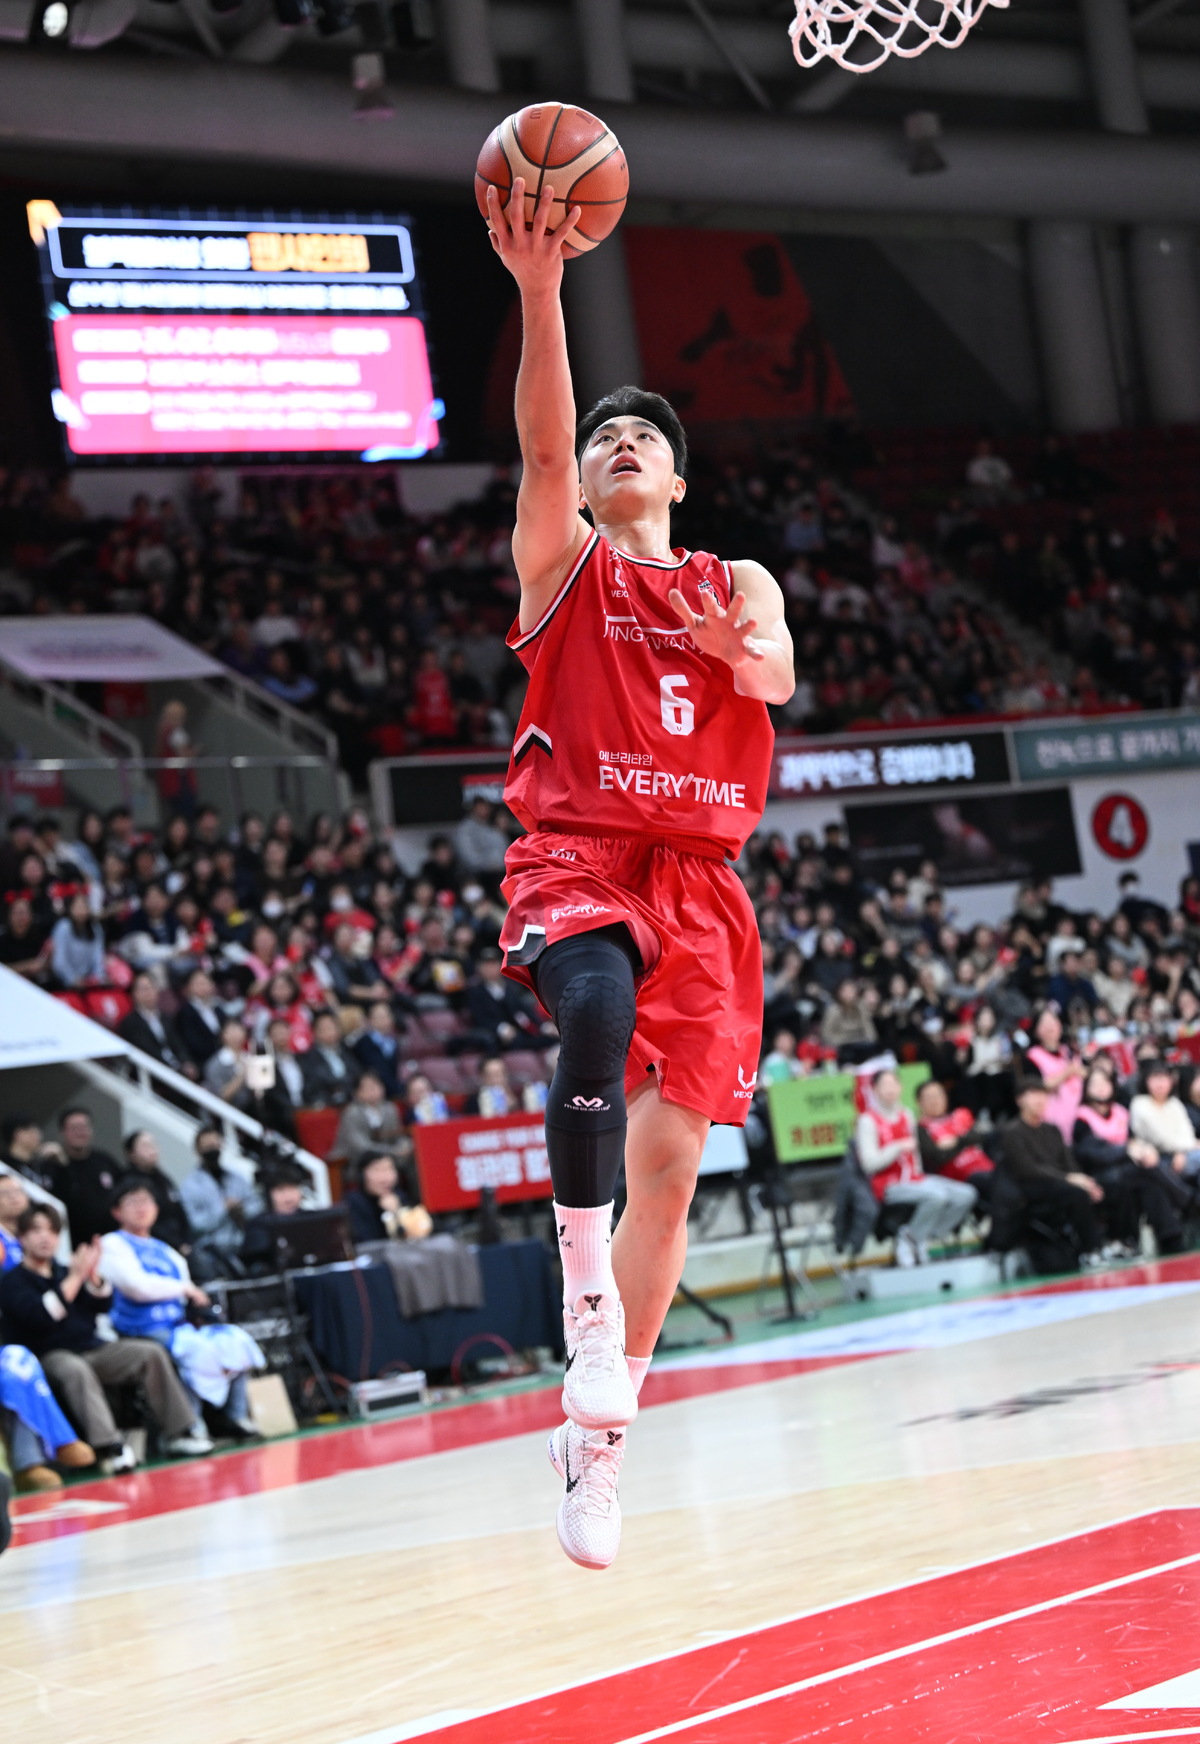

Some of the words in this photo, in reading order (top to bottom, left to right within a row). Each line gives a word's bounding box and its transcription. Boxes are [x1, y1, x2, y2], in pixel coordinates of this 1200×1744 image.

[659, 674, 695, 736] 6
[599, 750, 653, 766] 에브리타임
[1107, 802, 1136, 851] 4
